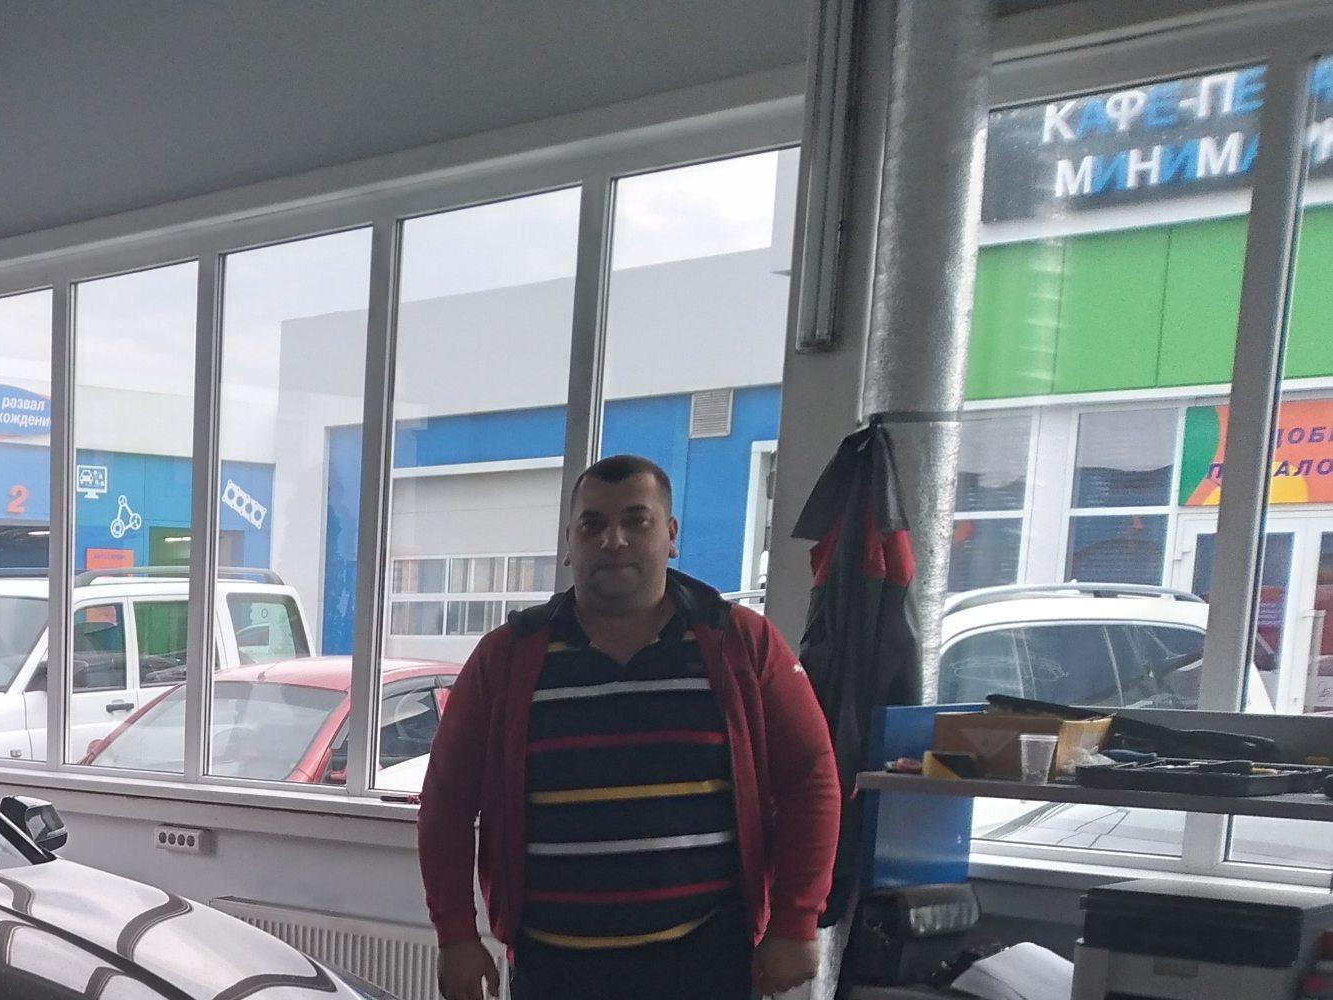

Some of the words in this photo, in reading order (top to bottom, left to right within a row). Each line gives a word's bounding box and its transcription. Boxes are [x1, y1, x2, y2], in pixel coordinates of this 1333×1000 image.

[1043, 58, 1333, 143] КАФЕ-ПЕ
[1, 397, 45, 411] развал
[7, 485, 28, 514] 2
